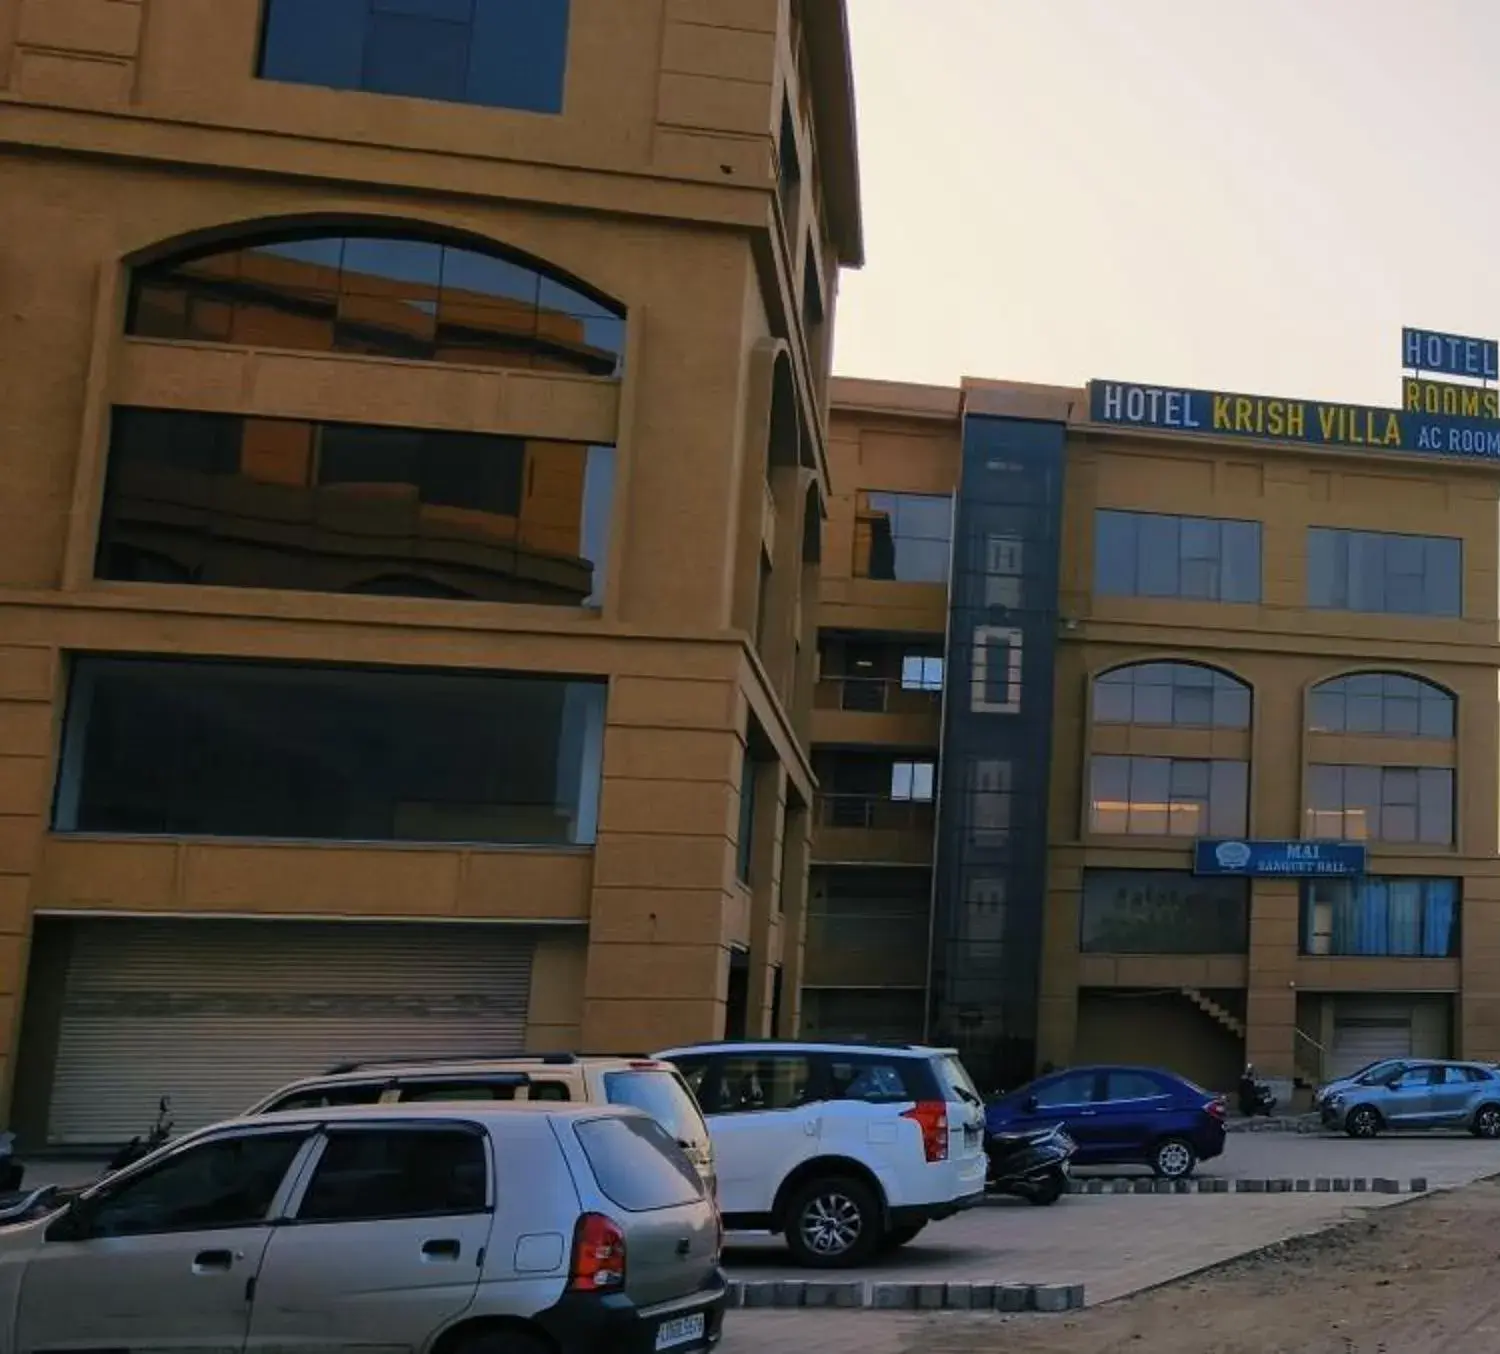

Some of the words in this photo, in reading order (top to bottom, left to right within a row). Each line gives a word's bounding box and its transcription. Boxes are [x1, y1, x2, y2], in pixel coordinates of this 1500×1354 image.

[1406, 332, 1497, 375] HOTEL
[1103, 384, 1200, 428] HOTEL
[1213, 395, 1305, 437] KRISH
[1318, 405, 1401, 446] VILLA
[1419, 425, 1442, 450] AC
[1406, 381, 1498, 419] ROOMS
[1316, 861, 1346, 874] HALL
